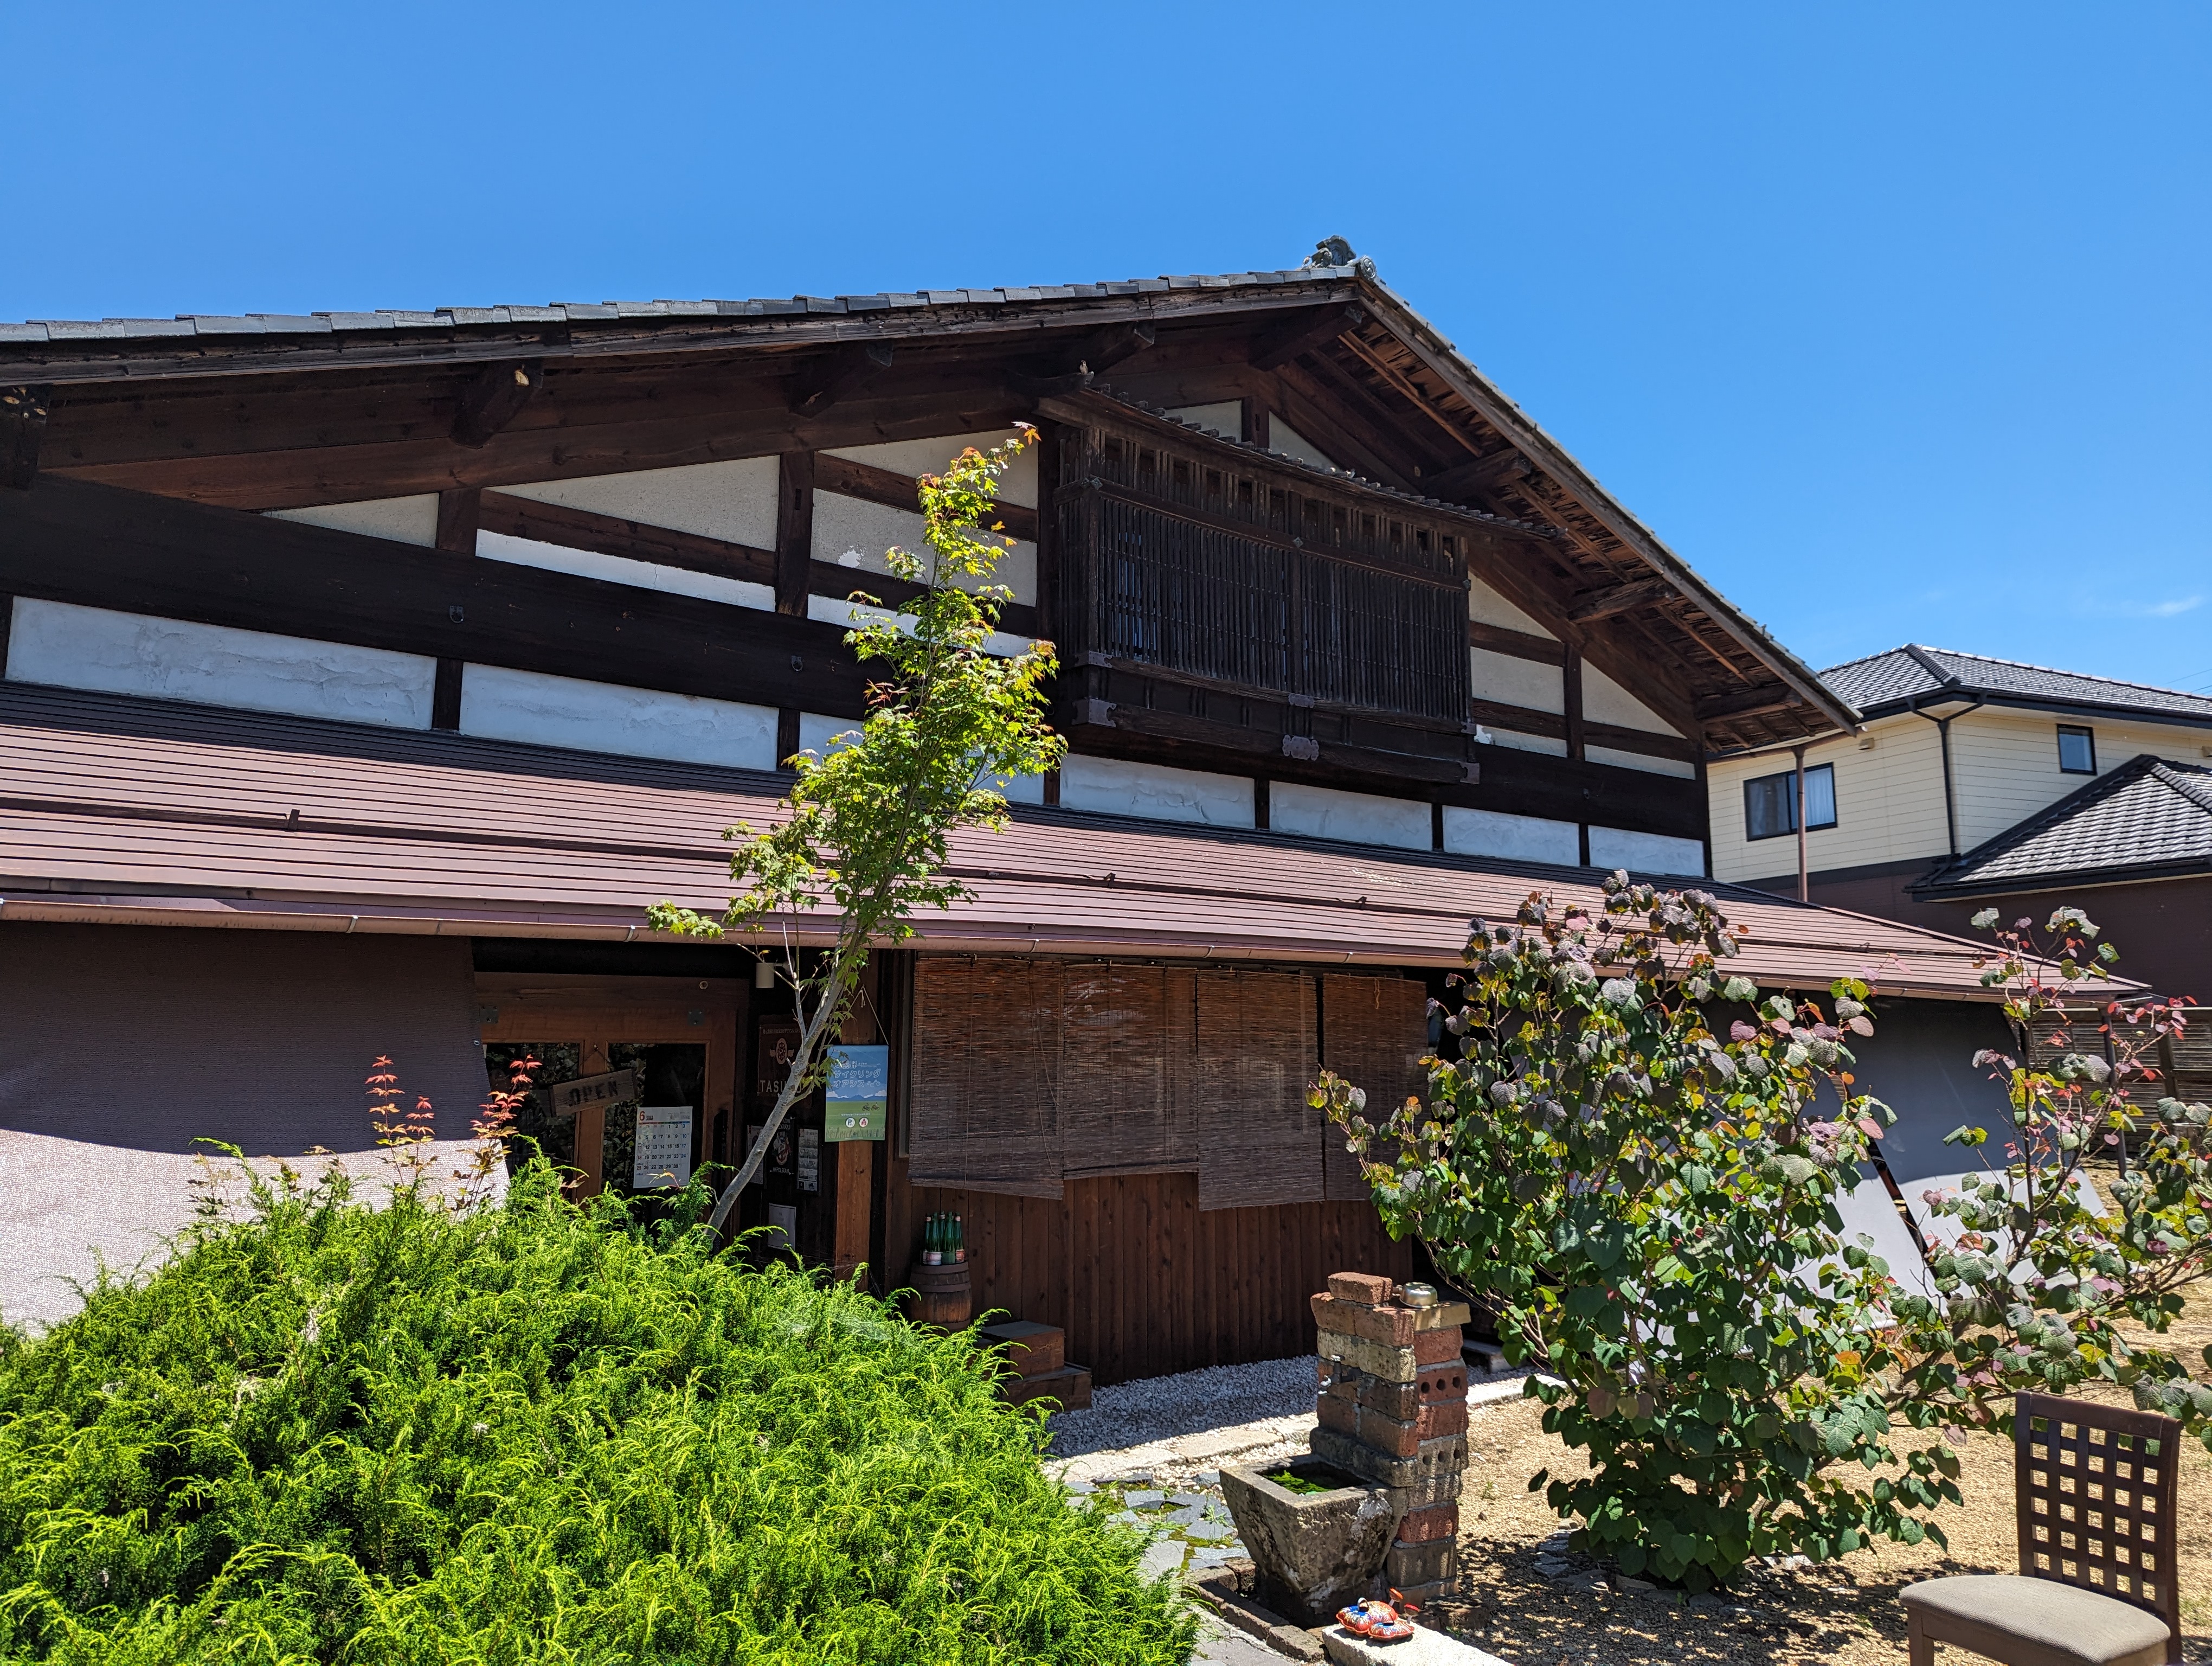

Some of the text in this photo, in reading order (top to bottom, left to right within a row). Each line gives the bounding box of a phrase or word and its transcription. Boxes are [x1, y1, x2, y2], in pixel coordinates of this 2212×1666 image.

[834, 1068, 882, 1078] サイクリング
[833, 1080, 865, 1088] オアシス
[569, 1080, 618, 1107] OPEN
[639, 1111, 645, 1121] 6
